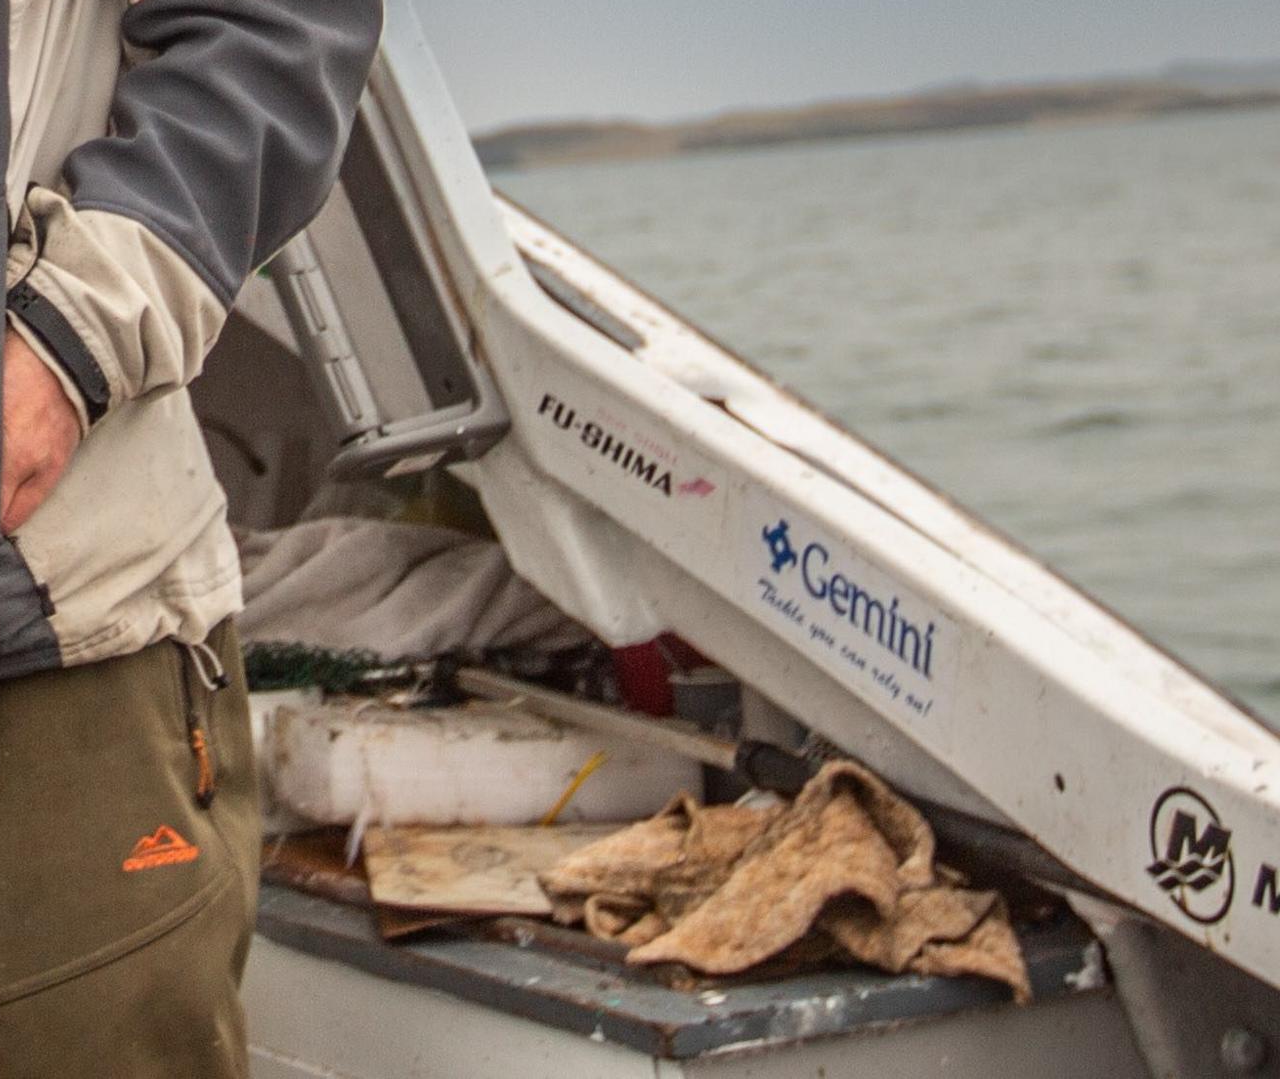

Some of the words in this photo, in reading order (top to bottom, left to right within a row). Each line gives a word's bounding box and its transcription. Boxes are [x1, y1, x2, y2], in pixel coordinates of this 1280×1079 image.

[757, 577, 804, 626] Tackle
[809, 623, 835, 649] you
[841, 645, 867, 671] can
[872, 667, 901, 700] rely
[801, 542, 935, 681] Gemini
